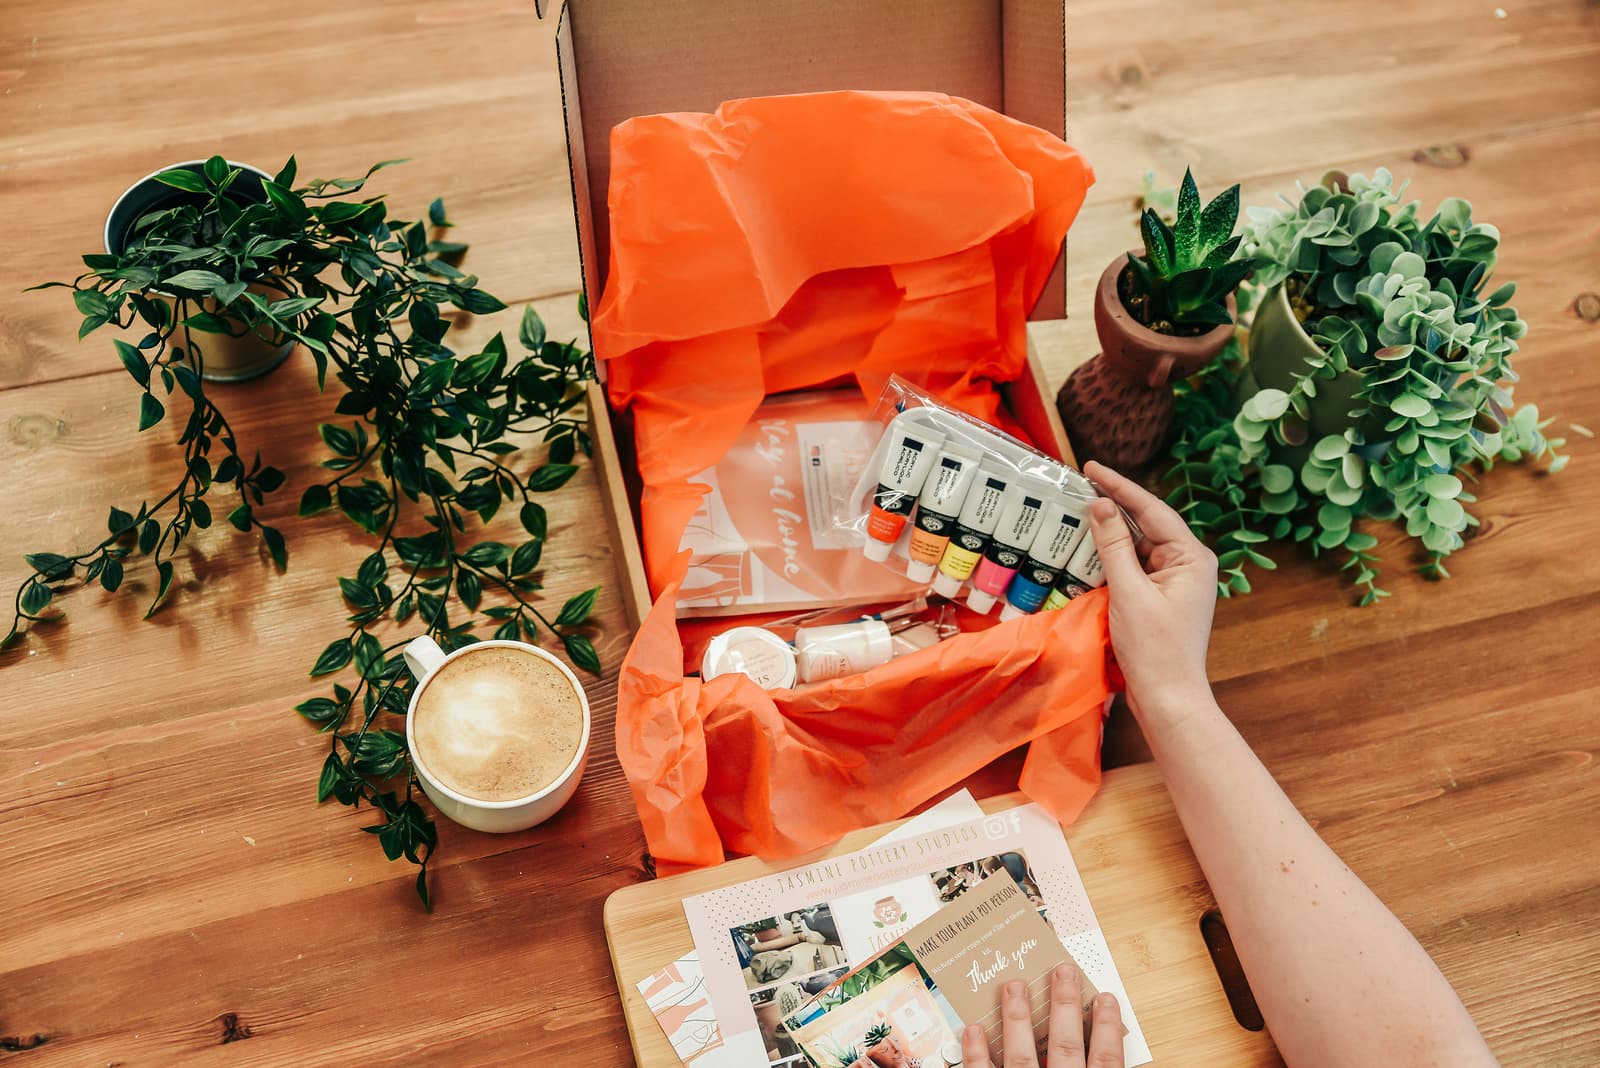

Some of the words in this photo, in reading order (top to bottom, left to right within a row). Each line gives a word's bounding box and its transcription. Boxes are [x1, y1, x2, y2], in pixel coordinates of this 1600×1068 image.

[769, 475, 794, 502] at
[897, 449, 912, 484] ACRYLIQUE
[905, 451, 918, 479] ACRYLIC
[772, 508, 801, 578] home
[777, 863, 842, 894] JASMINE
[850, 844, 908, 872] POTTERY
[916, 825, 978, 854] STUDIOS
[915, 936, 940, 959] MAKE
[935, 924, 958, 945] YOUR
[954, 910, 979, 932] PLANT
[977, 901, 991, 917] POT
[989, 884, 1018, 908] PERSON
[966, 950, 1009, 992] Thank
[1011, 938, 1037, 970] you
